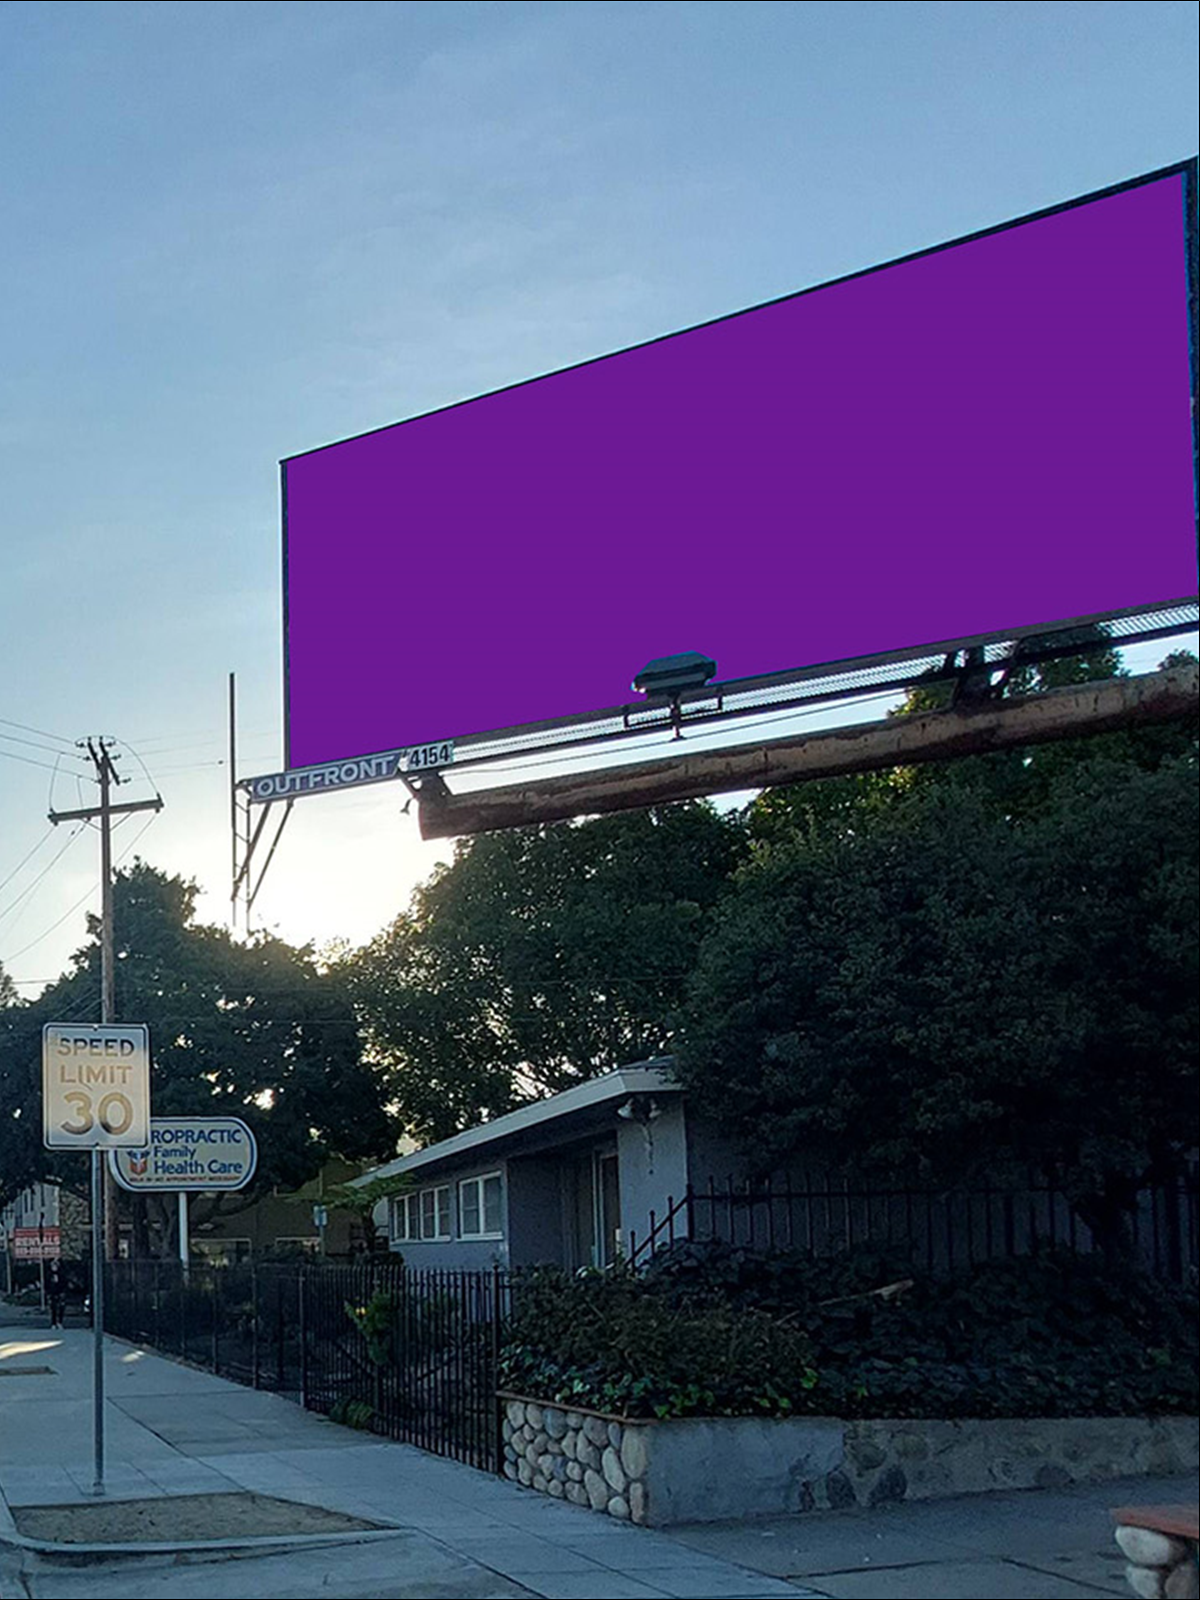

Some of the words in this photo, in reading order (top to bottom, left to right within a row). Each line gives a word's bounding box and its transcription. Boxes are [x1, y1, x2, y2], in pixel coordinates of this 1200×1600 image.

[409, 743, 450, 768] 4154
[256, 755, 394, 797] OUTFRONT
[57, 1037, 134, 1057] SPEED
[60, 1065, 133, 1084] LIMIT
[60, 1091, 134, 1136] 30
[151, 1128, 242, 1144] ROPRACTIC
[153, 1145, 197, 1160] Family
[153, 1160, 205, 1175] Health
[206, 1159, 243, 1174] Care
